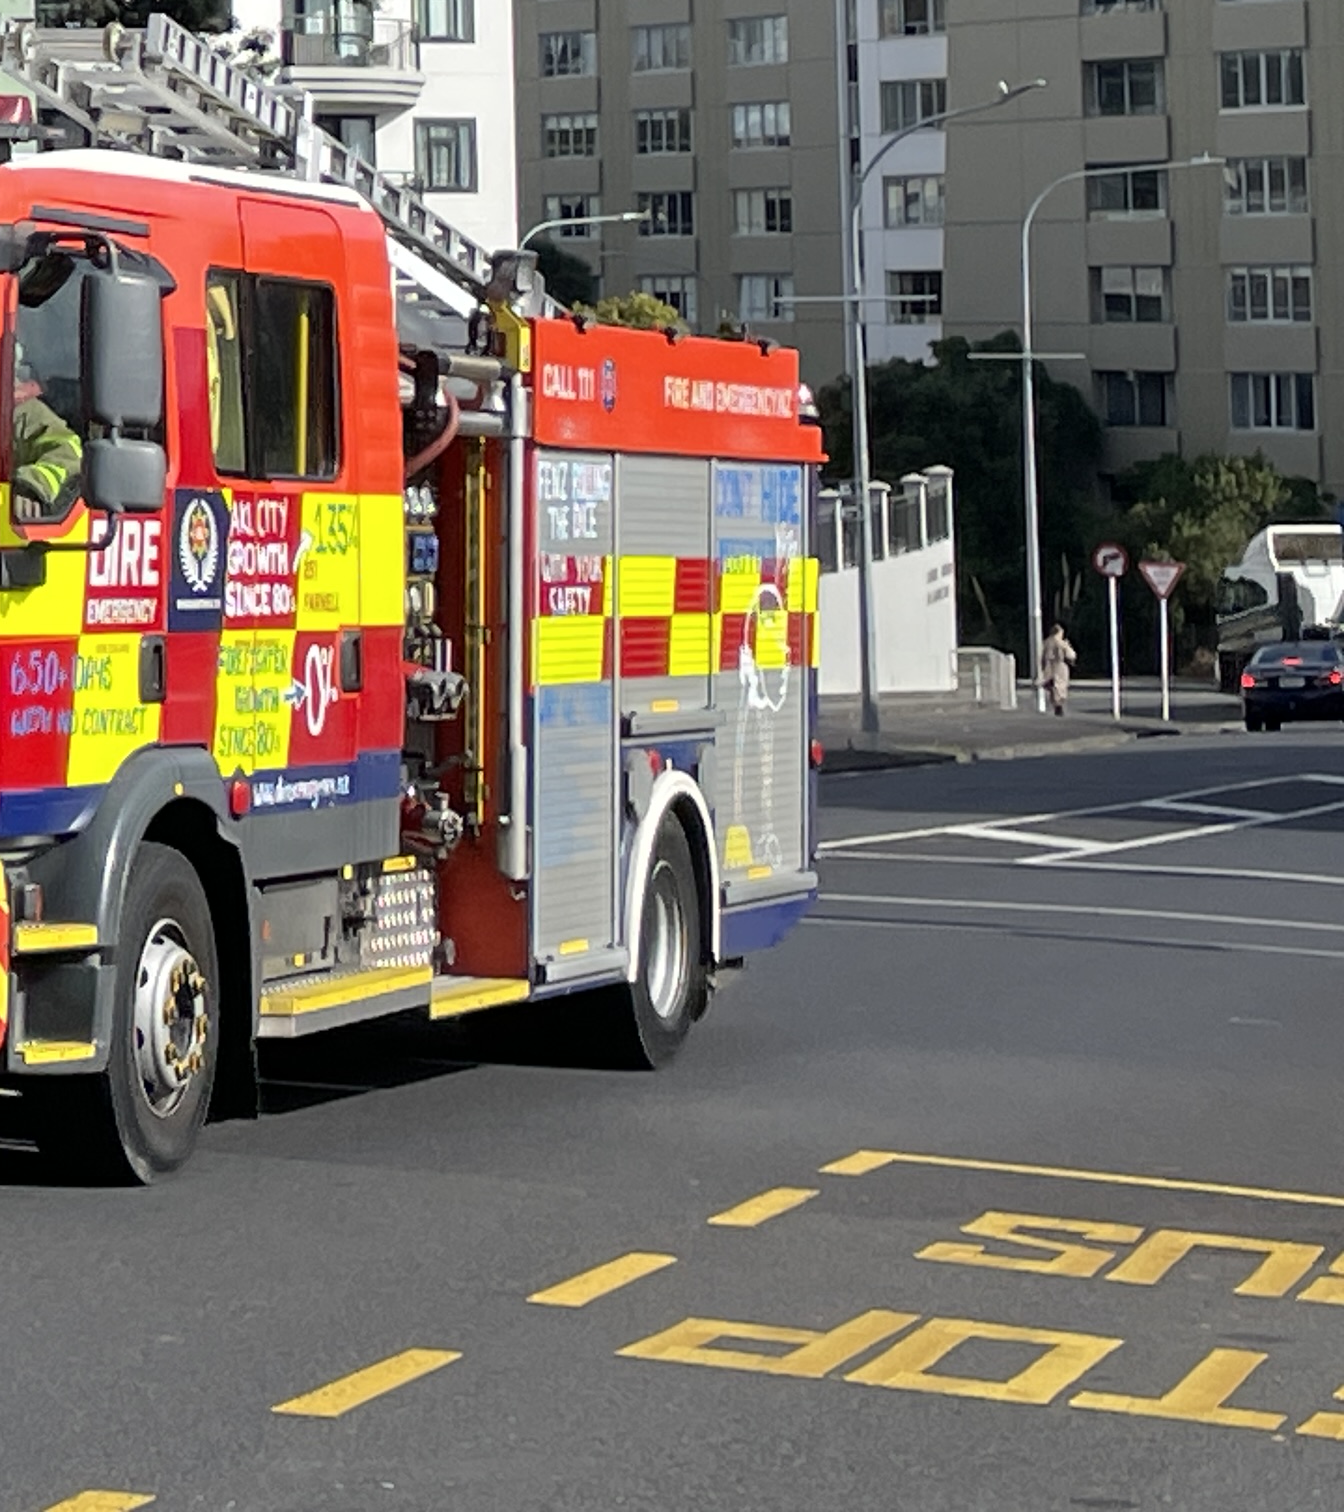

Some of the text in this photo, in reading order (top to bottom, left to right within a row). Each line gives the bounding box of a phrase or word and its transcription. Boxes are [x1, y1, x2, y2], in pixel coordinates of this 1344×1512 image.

[543, 363, 577, 400] CALL
[664, 375, 690, 411] FIRE
[691, 379, 714, 412] AND
[256, 497, 289, 538] CITY
[546, 504, 569, 540] THE
[227, 540, 289, 576] GROWTH
[225, 581, 272, 618] SINCE
[71, 655, 112, 692] DAYS
[82, 707, 147, 737] CONTRACT
